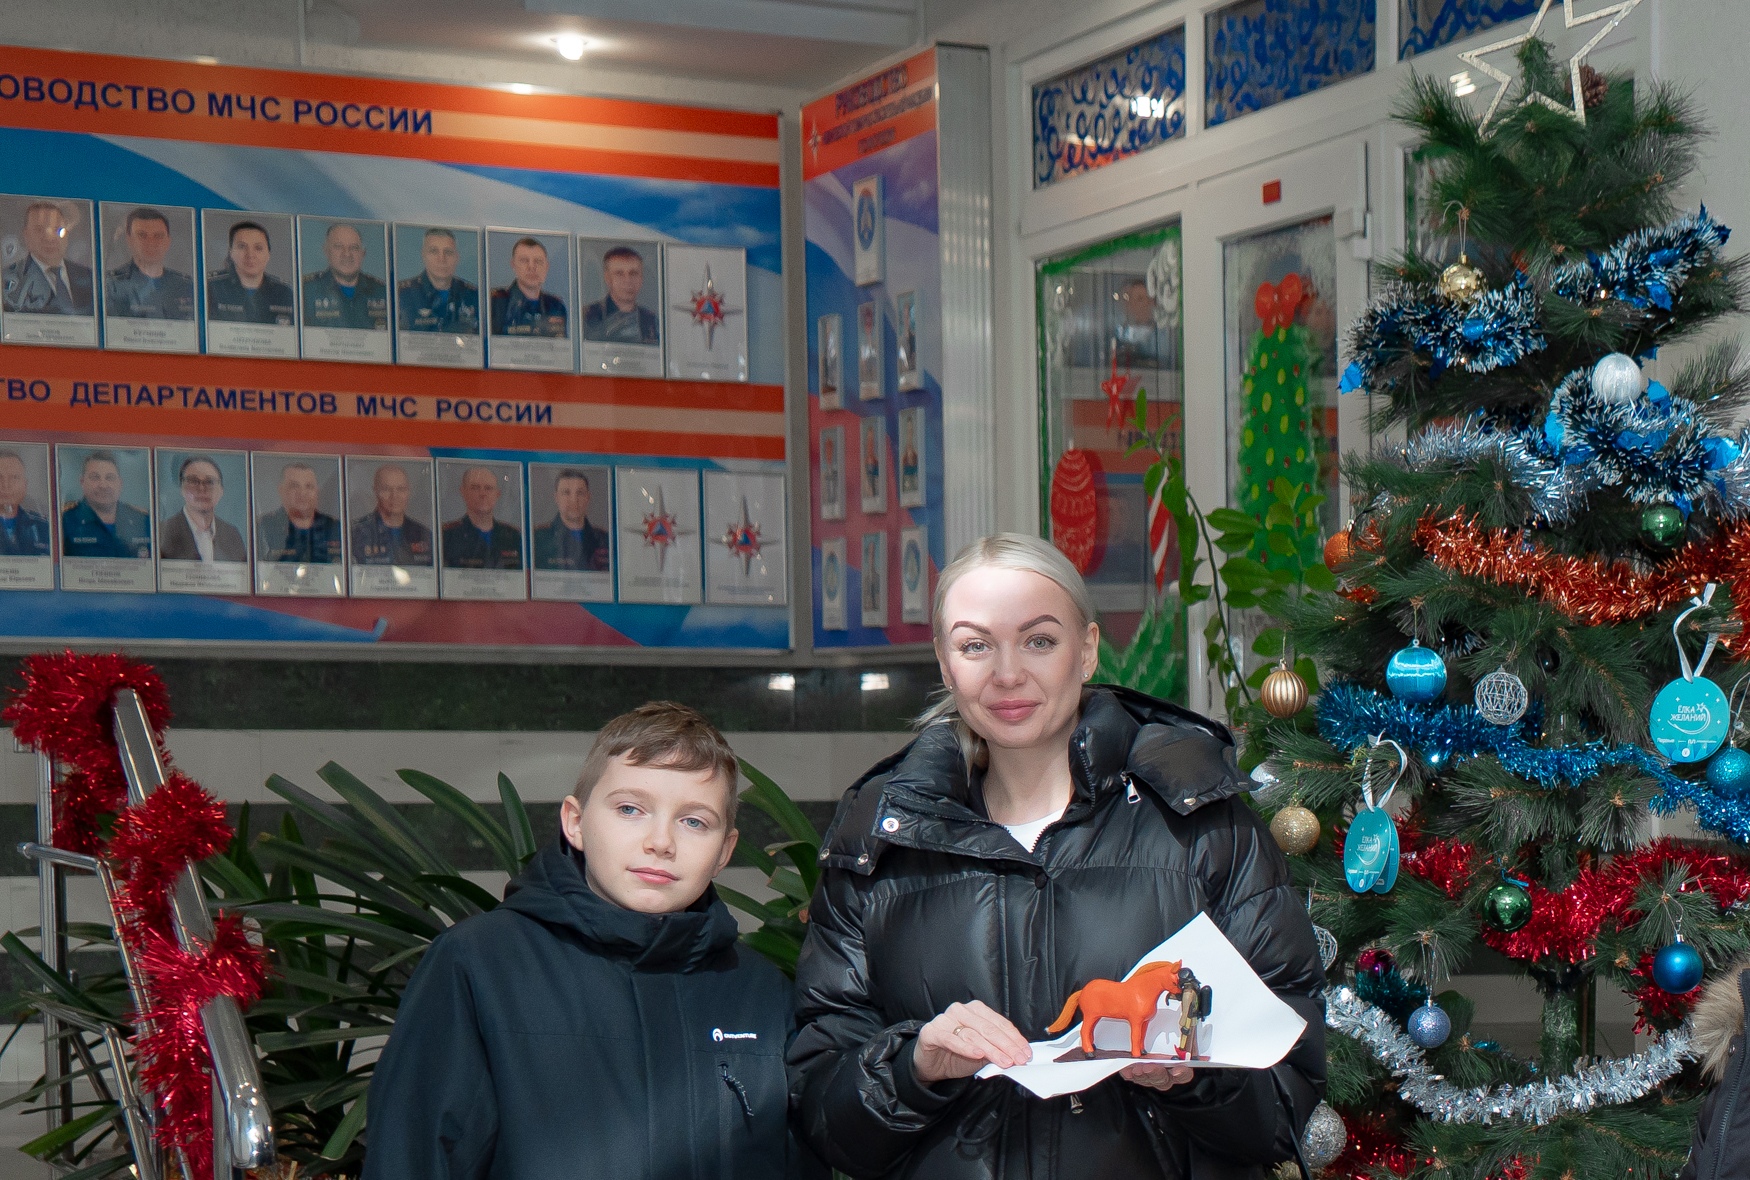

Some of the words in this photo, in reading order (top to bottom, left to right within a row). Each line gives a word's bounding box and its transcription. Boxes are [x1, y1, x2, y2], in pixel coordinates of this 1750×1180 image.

[207, 92, 281, 121] МЧС
[293, 100, 433, 135] РОССИИ
[70, 382, 338, 415] ДЕПАРТАМЕНТОВ
[357, 396, 418, 418] МЧС
[436, 400, 553, 424] РОССИИ
